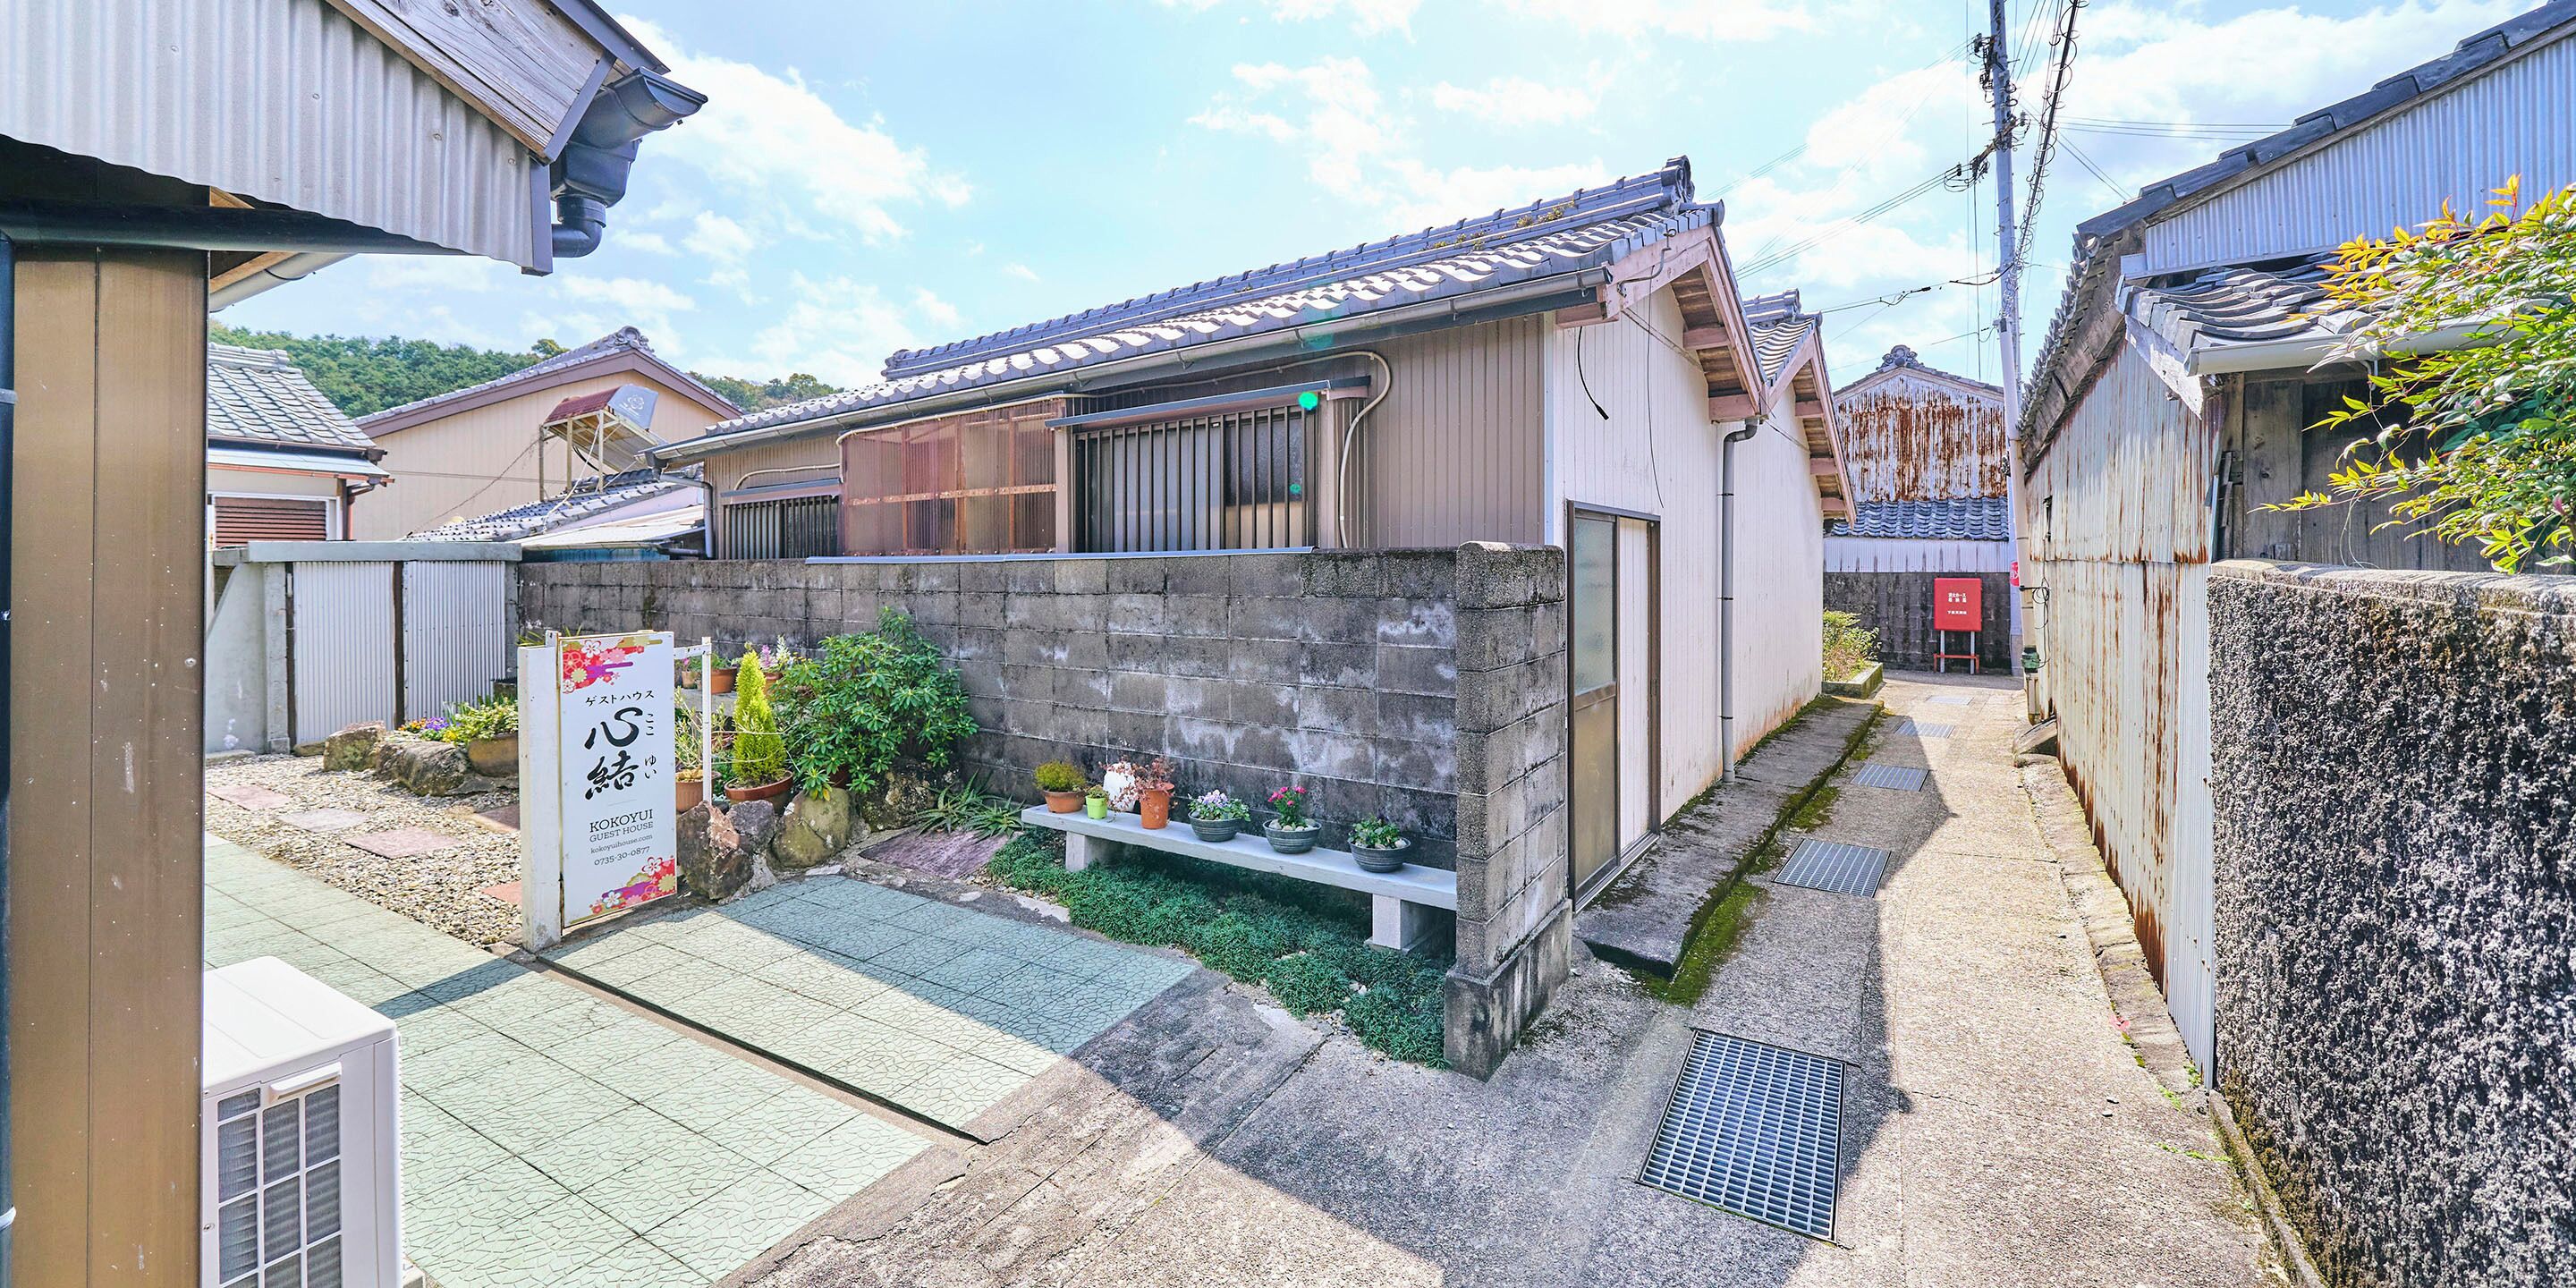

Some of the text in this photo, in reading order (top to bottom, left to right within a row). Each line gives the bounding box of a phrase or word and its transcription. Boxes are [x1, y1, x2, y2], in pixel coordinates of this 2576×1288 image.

[585, 690, 655, 707] ゲストハウス
[584, 707, 644, 801] 心結
[589, 809, 654, 833] KOKOYUI
[589, 821, 654, 843] GUEST HOUSE
[590, 834, 653, 854] kokoyuihouse.com
[594, 845, 650, 866] 0735-30-0877
